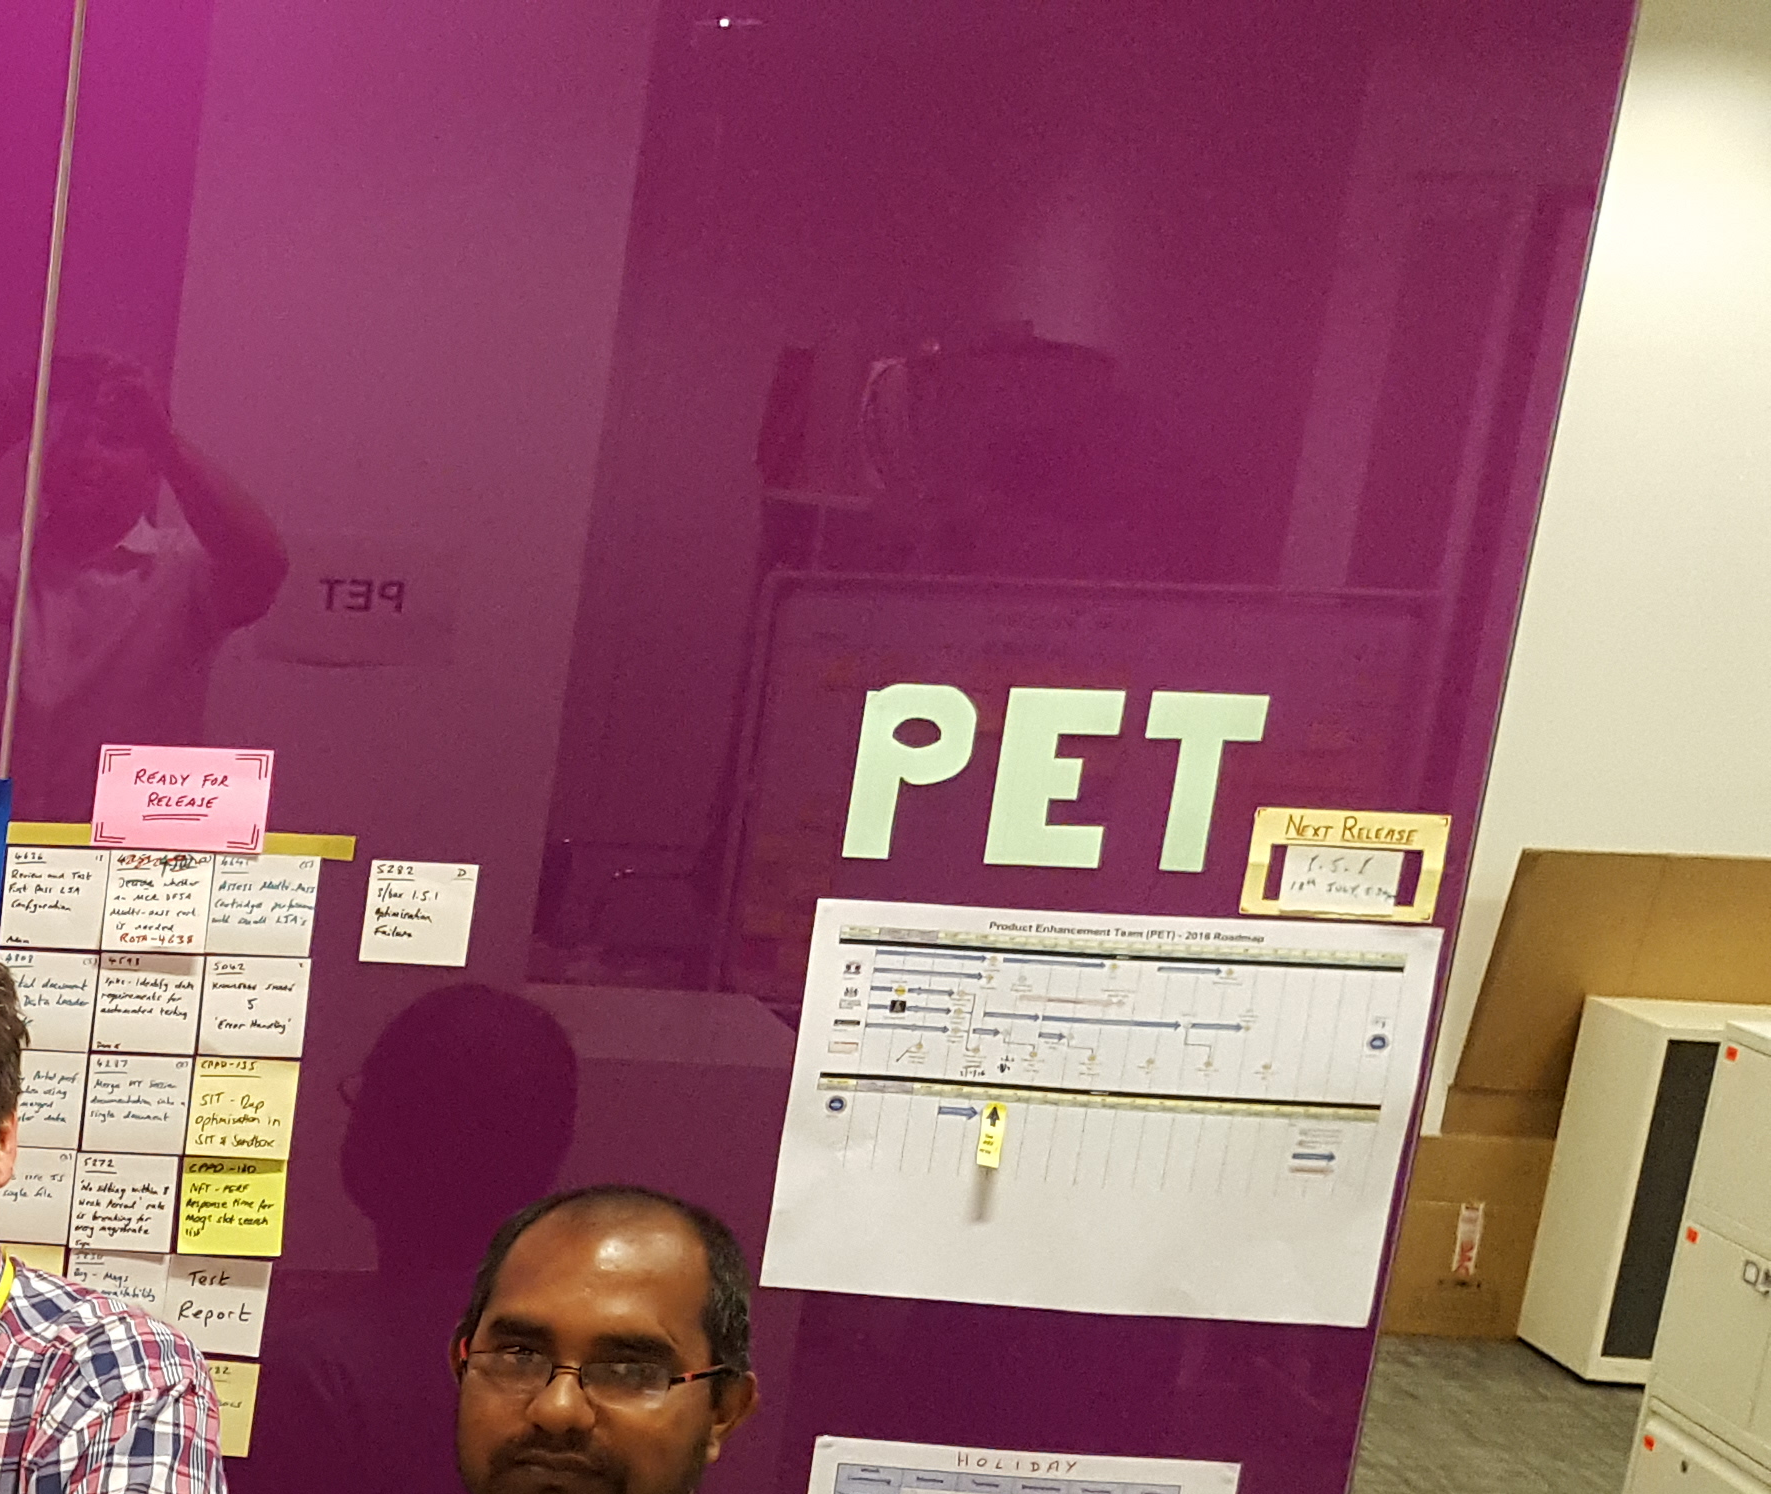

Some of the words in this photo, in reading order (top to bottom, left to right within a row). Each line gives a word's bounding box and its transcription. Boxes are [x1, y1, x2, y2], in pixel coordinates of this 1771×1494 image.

[134, 768, 190, 787] READY
[202, 773, 229, 788] FOR
[841, 682, 1271, 873] PET
[147, 792, 219, 809] RELEASE
[1285, 814, 1333, 839] NEXT
[1342, 816, 1419, 844] RELEASE
[376, 864, 414, 875] 5282
[989, 921, 1033, 933] Product
[1035, 923, 1111, 937] Enhancement
[1113, 927, 1143, 938] Team
[1146, 928, 1176, 941] (PET)
[1213, 932, 1265, 944] Roadmap
[247, 998, 258, 1010] 5
[267, 1117, 281, 1127] in
[188, 1270, 231, 1287] Test
[177, 1300, 252, 1327] Report
[958, 1451, 1078, 1472] HOLIDAY
